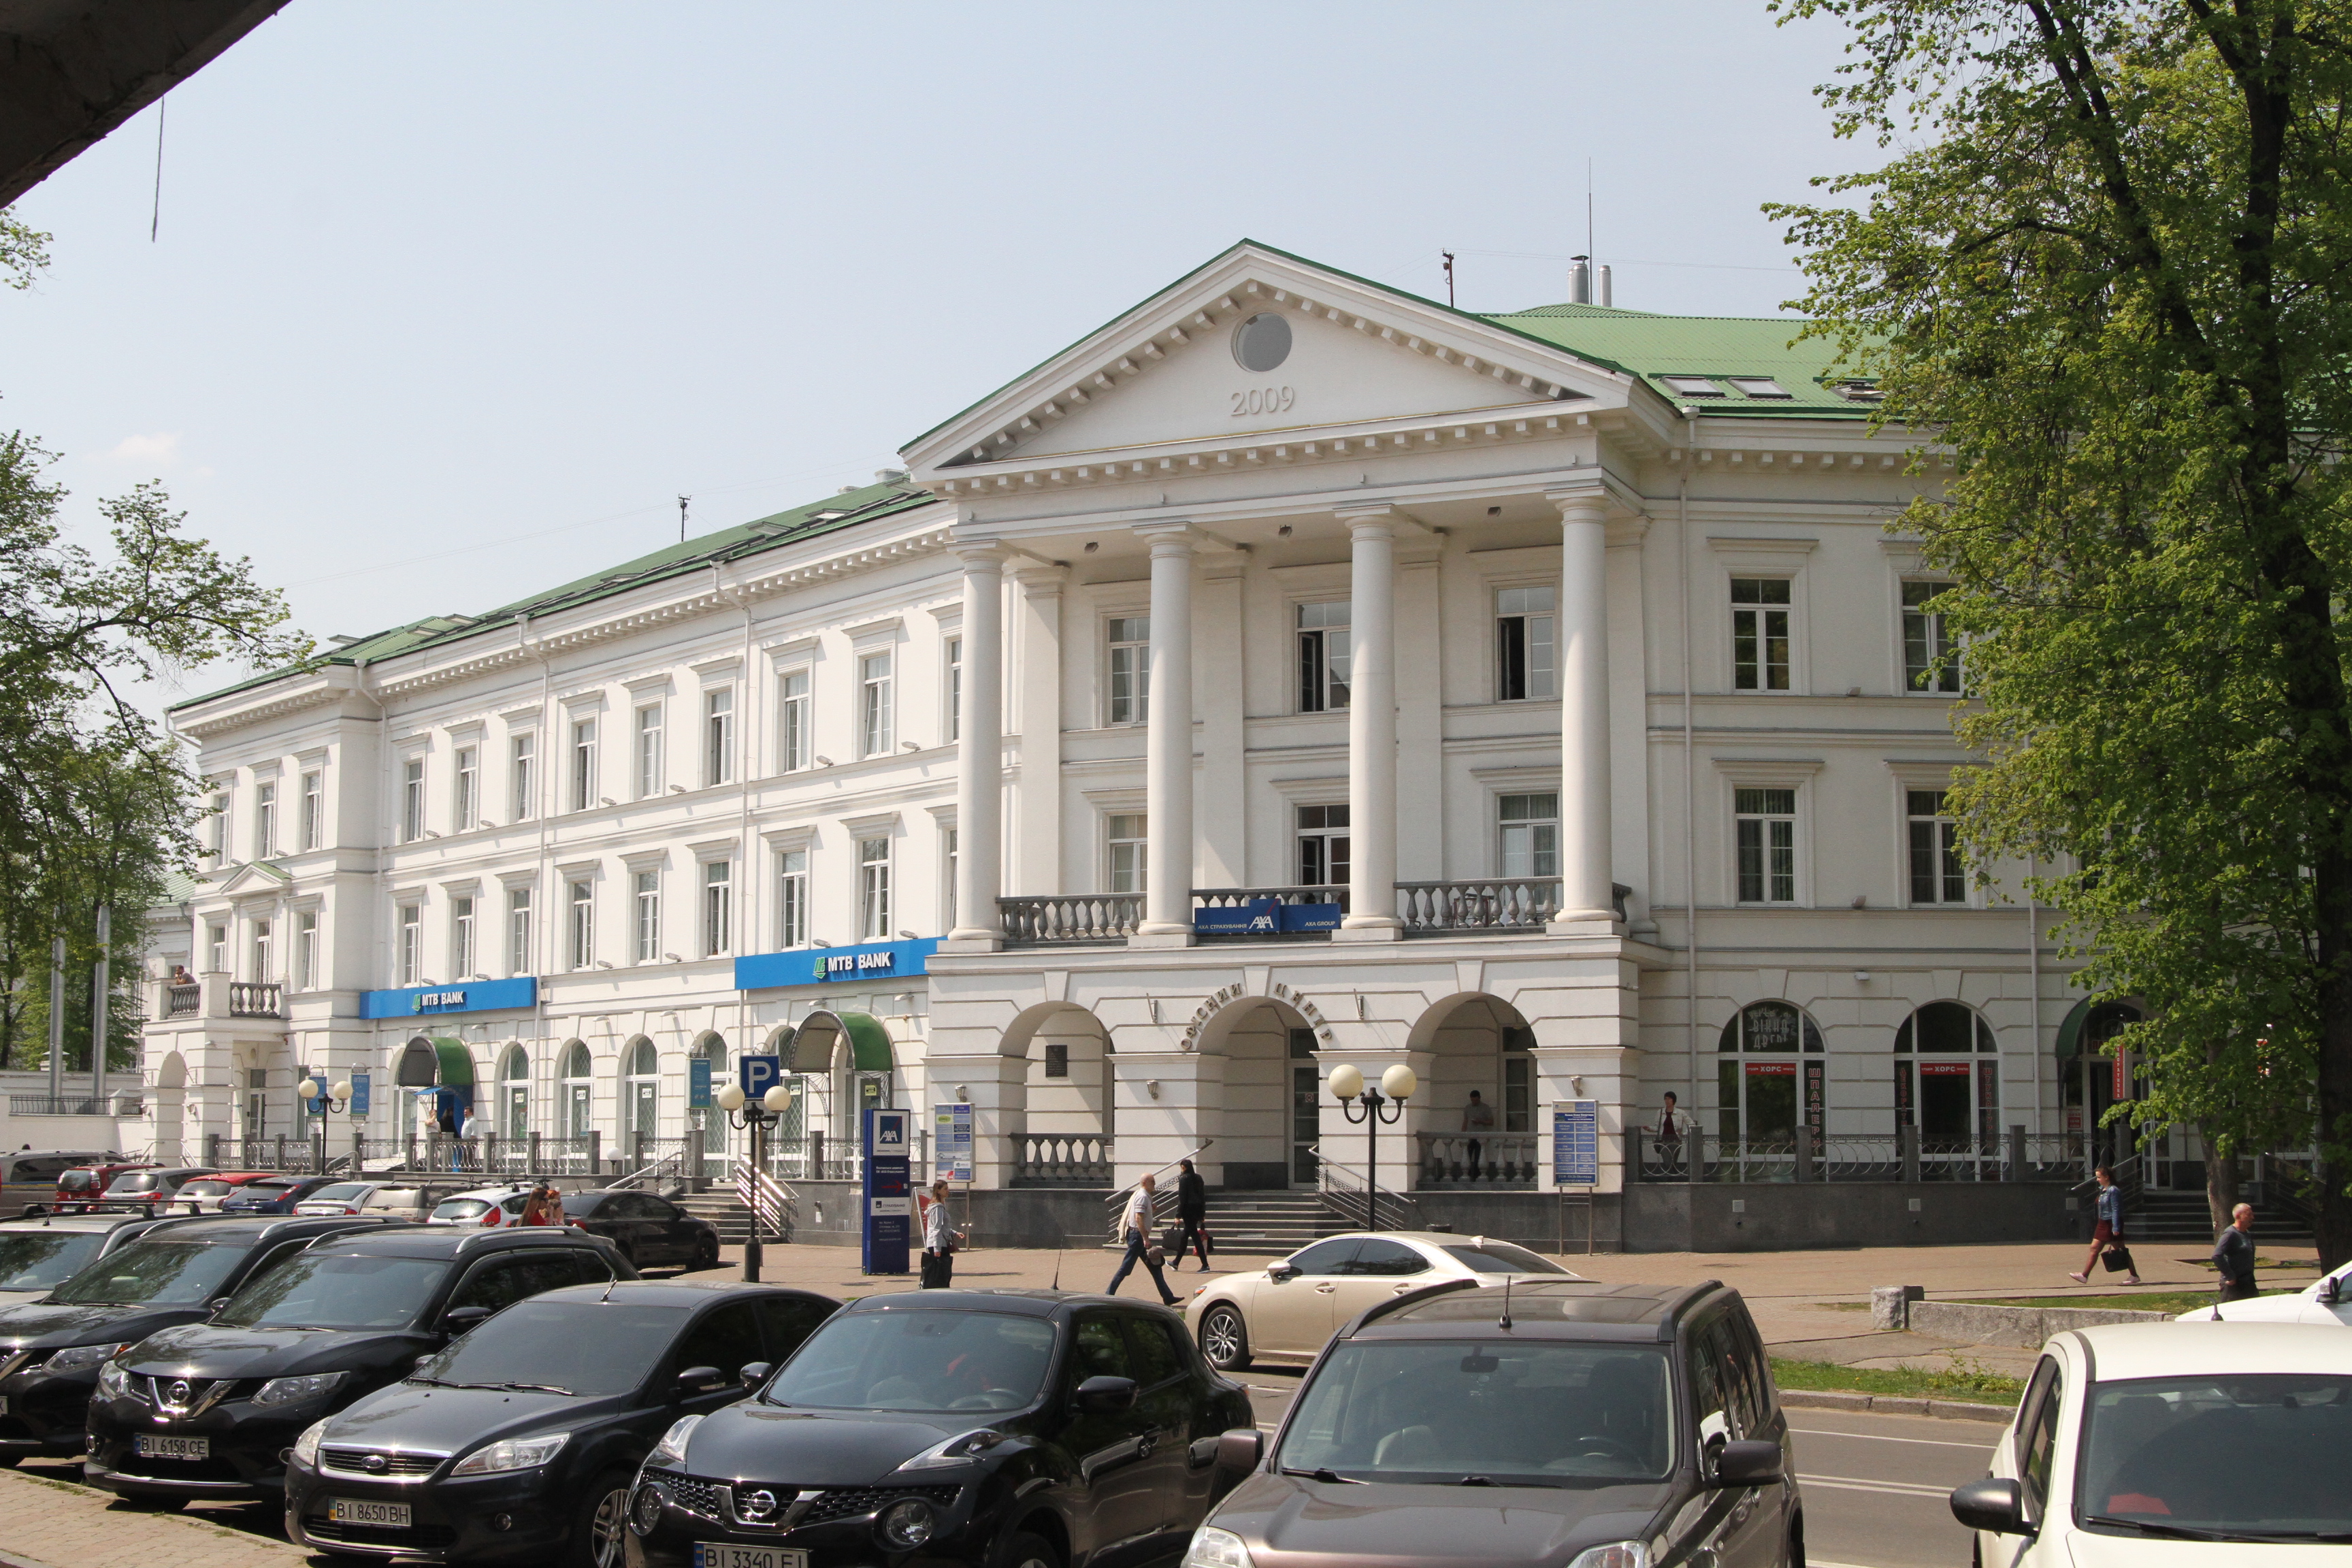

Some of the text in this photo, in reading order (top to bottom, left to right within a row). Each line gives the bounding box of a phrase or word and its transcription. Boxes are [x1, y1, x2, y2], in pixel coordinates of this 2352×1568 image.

[1230, 386, 1294, 416] 2009
[1249, 915, 1275, 930] AXA
[828, 951, 891, 972] MTB BANK
[422, 991, 464, 1006] MTB BANK
[1273, 983, 1333, 1041] ЦЕНТР
[749, 1061, 771, 1094] P
[1808, 1068, 1821, 1147] ШПАЛЕРИ
[879, 1130, 898, 1142] AXA
[161, 1439, 186, 1453] 6158
[189, 1441, 206, 1454] CE
[357, 1504, 386, 1520] 8650
[389, 1506, 408, 1522] BH
[732, 1550, 772, 1568] 3340
